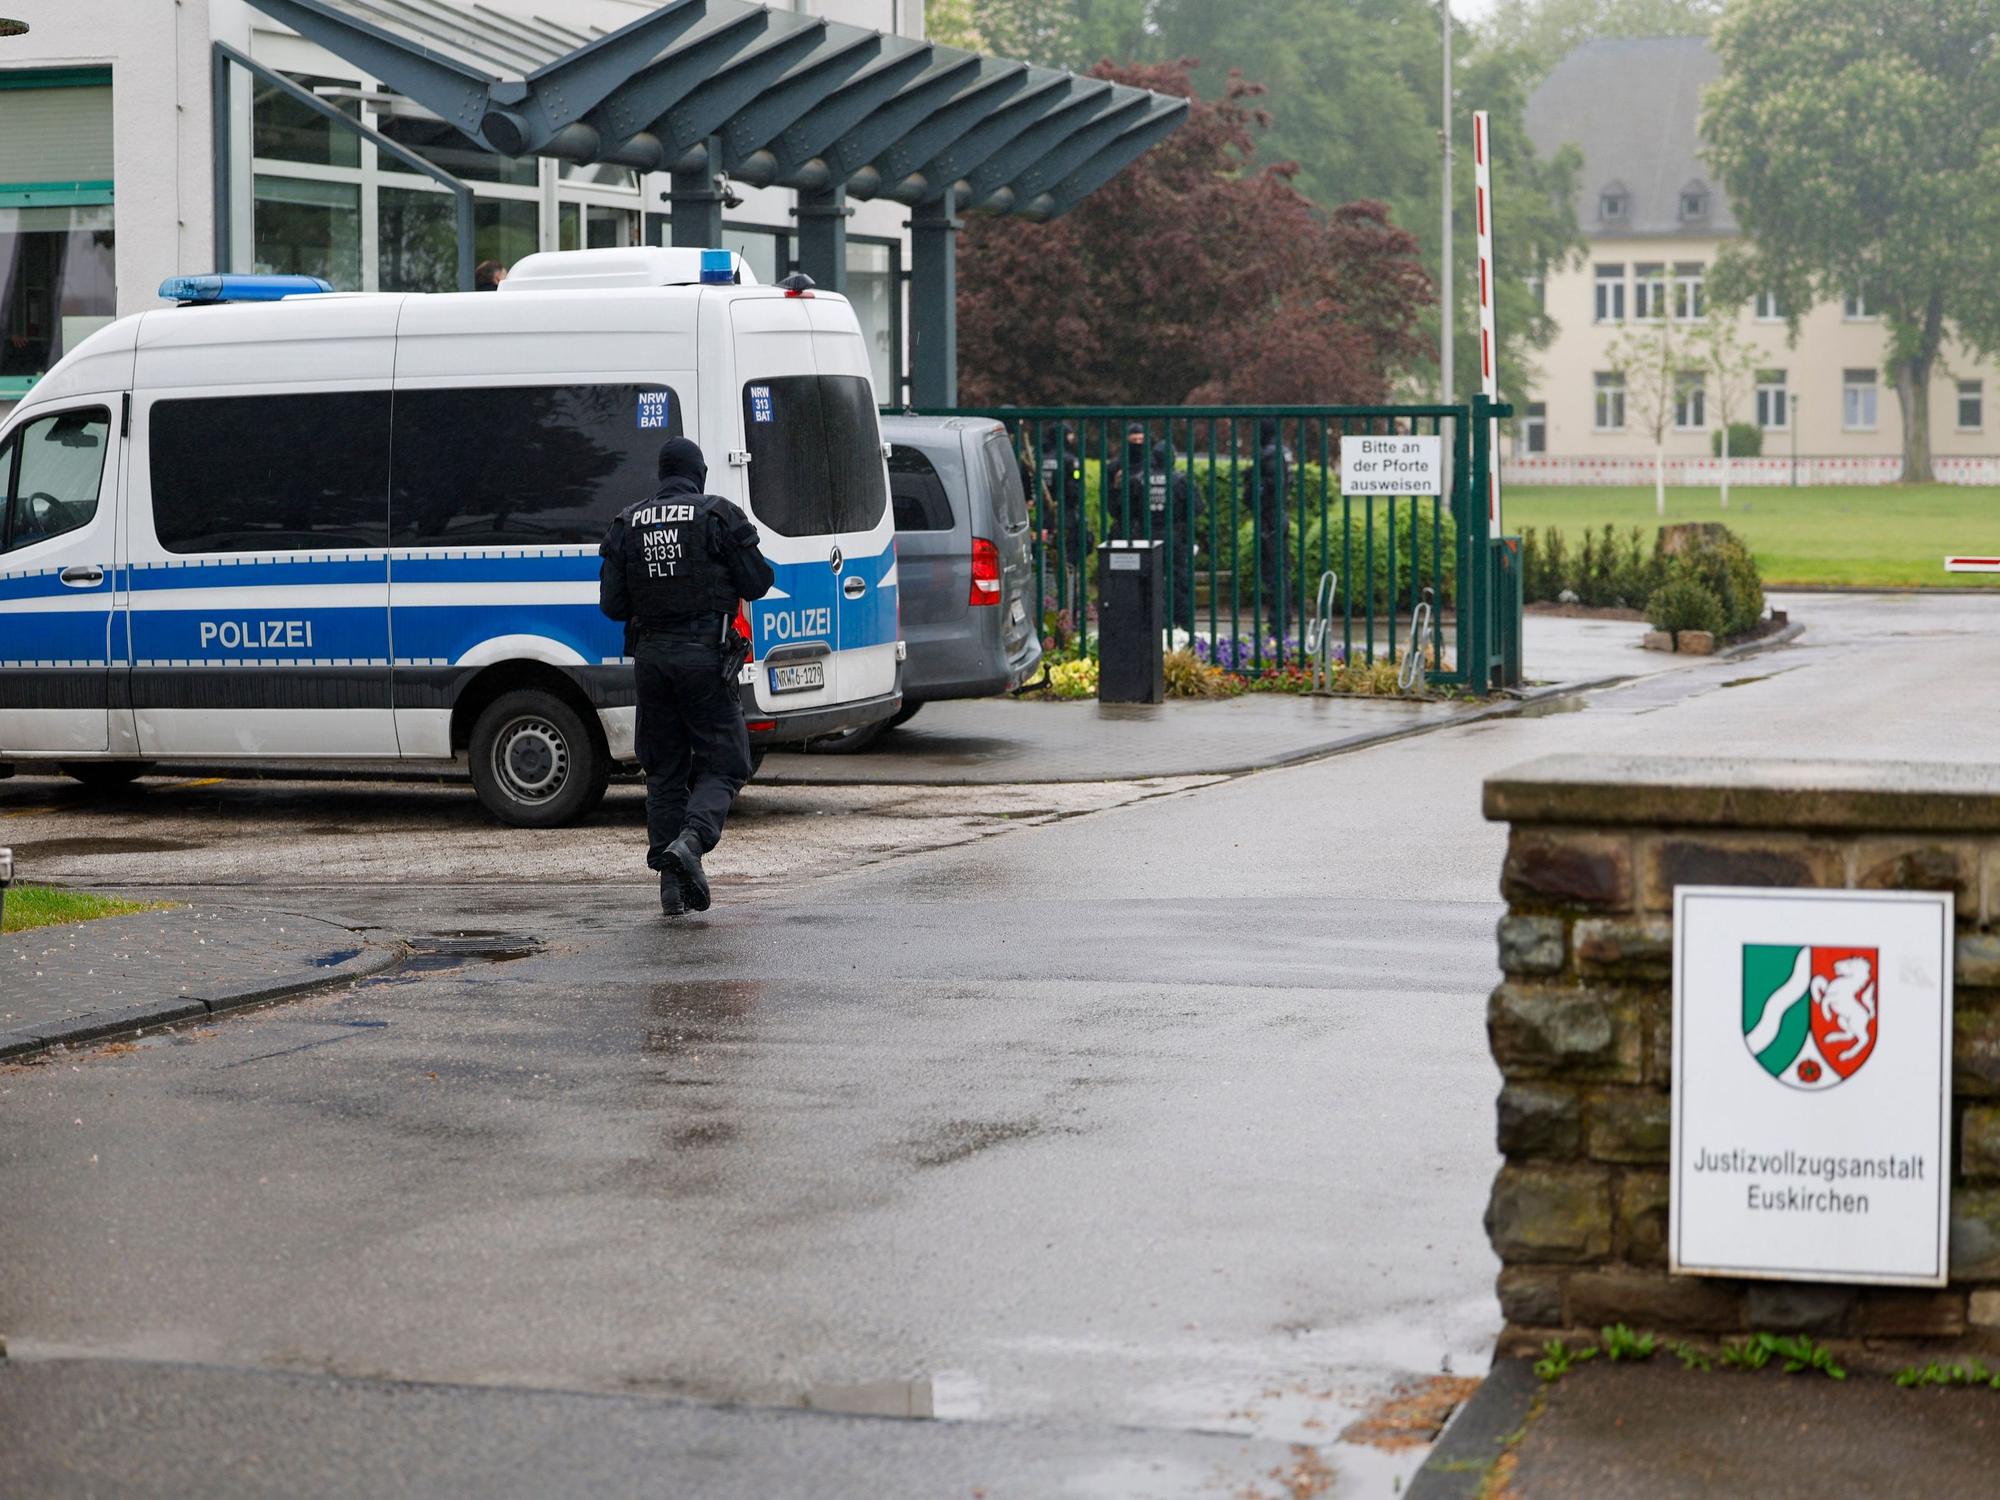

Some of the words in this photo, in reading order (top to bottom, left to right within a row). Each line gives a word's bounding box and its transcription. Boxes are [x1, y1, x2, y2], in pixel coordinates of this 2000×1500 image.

[639, 392, 667, 404] NRW
[751, 386, 769, 398] NRW
[643, 405, 663, 416] 313
[755, 399, 769, 409] 313
[641, 416, 664, 428] BAT
[755, 410, 770, 422] BAT
[1362, 441, 1397, 454] Bitte
[1402, 443, 1420, 454] an
[1353, 460, 1378, 472] der
[1383, 459, 1429, 472] Pforte
[1350, 478, 1431, 491] ausweisen
[631, 505, 694, 527] POLIZEI
[643, 529, 678, 547] NRW
[644, 544, 682, 562] 31331
[648, 561, 676, 578] FLT
[763, 607, 831, 641] POLIZEI
[200, 621, 313, 648] POLIZEI
[776, 669, 791, 688] NRW
[1694, 1148, 1925, 1181] Justizvollzugsanstalt
[1747, 1185, 1869, 1214] Euskirchen
